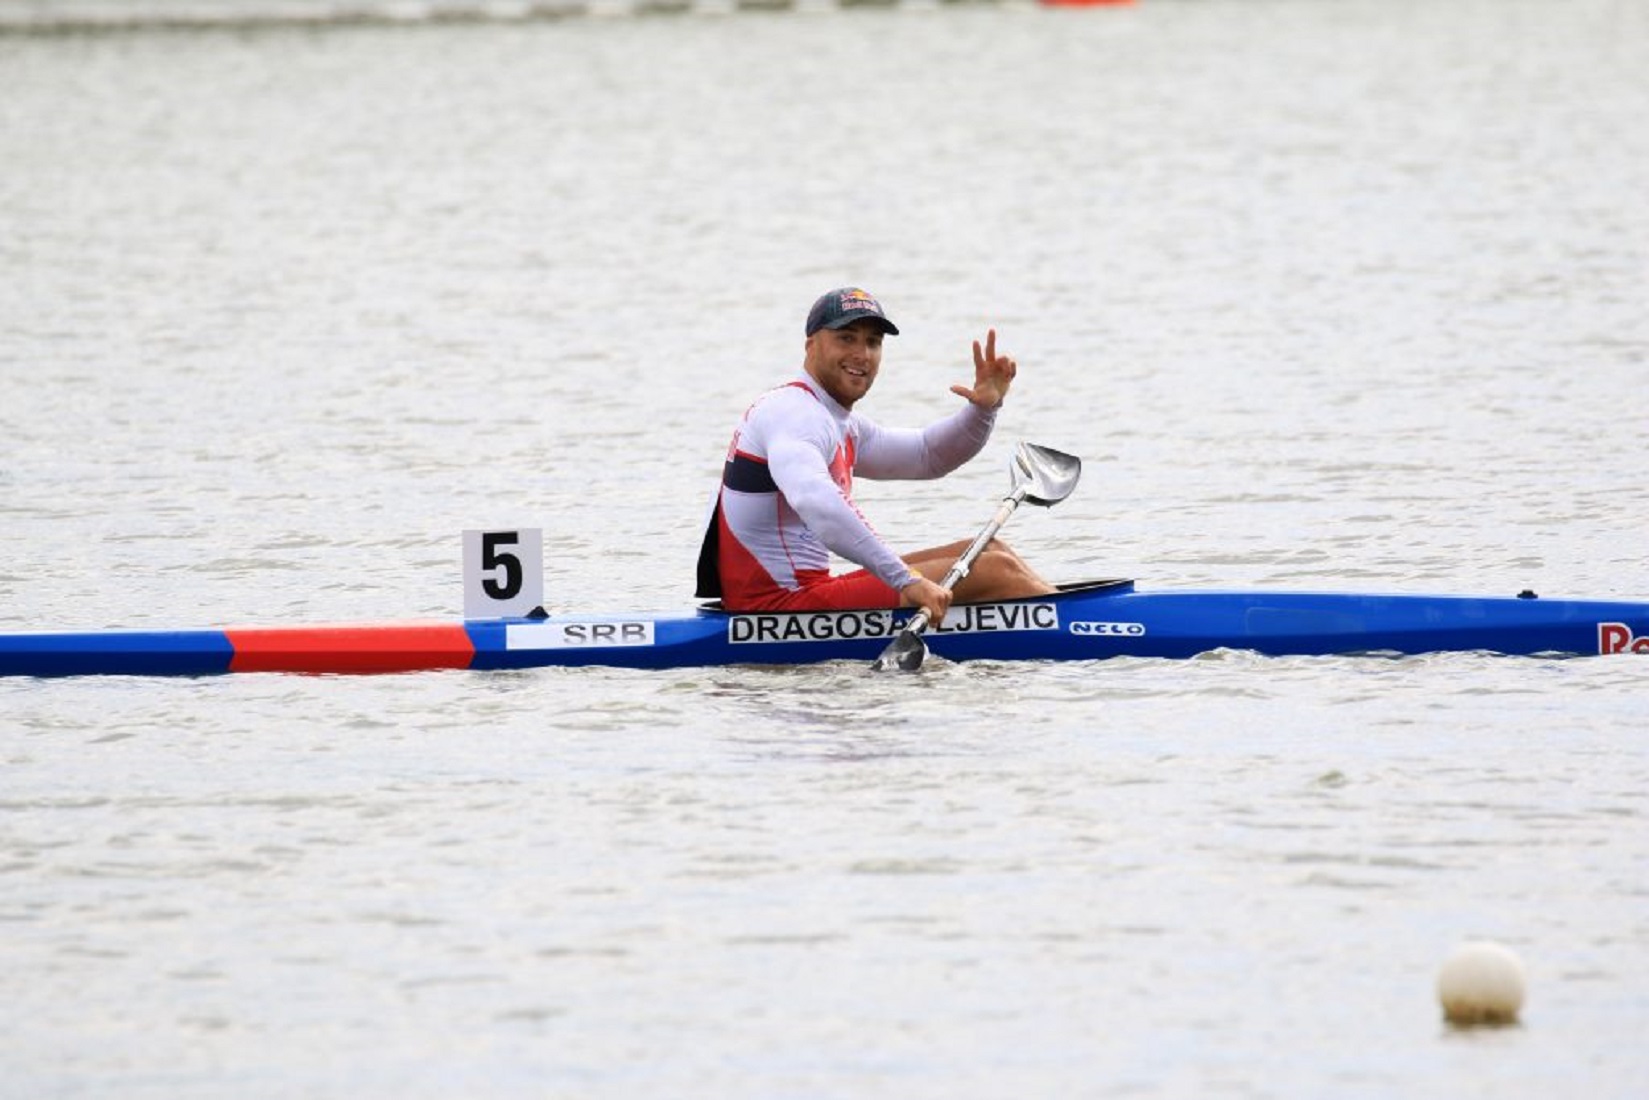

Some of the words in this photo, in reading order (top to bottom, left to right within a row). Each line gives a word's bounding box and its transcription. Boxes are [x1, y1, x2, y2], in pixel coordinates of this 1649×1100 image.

[482, 531, 523, 600] 5
[564, 623, 646, 644] SRB
[732, 605, 1055, 641] DRAGOSALJEVIC
